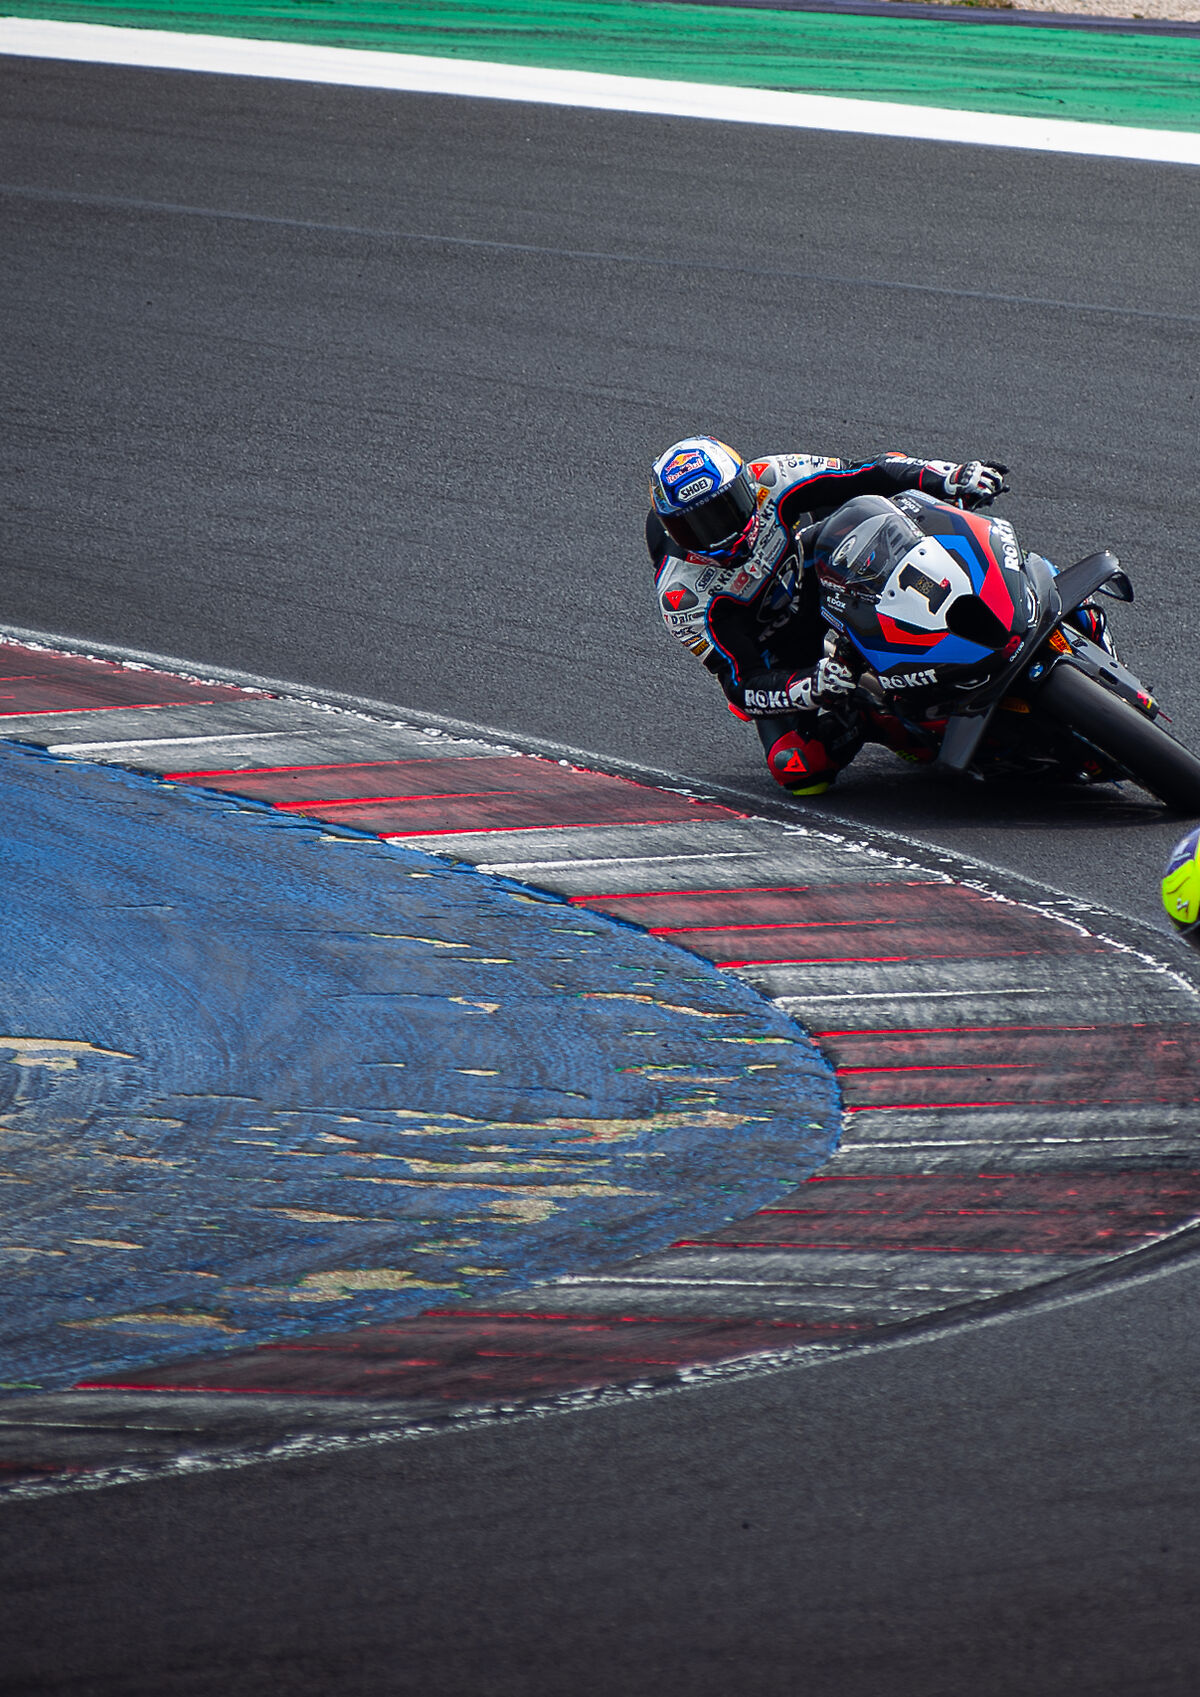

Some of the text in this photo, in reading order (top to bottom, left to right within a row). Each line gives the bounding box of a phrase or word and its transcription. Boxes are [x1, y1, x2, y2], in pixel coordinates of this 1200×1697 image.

[680, 478, 709, 499] SHOEI
[897, 562, 953, 616] 1
[878, 668, 939, 691] ROKiT
[744, 689, 790, 709] ROKi
